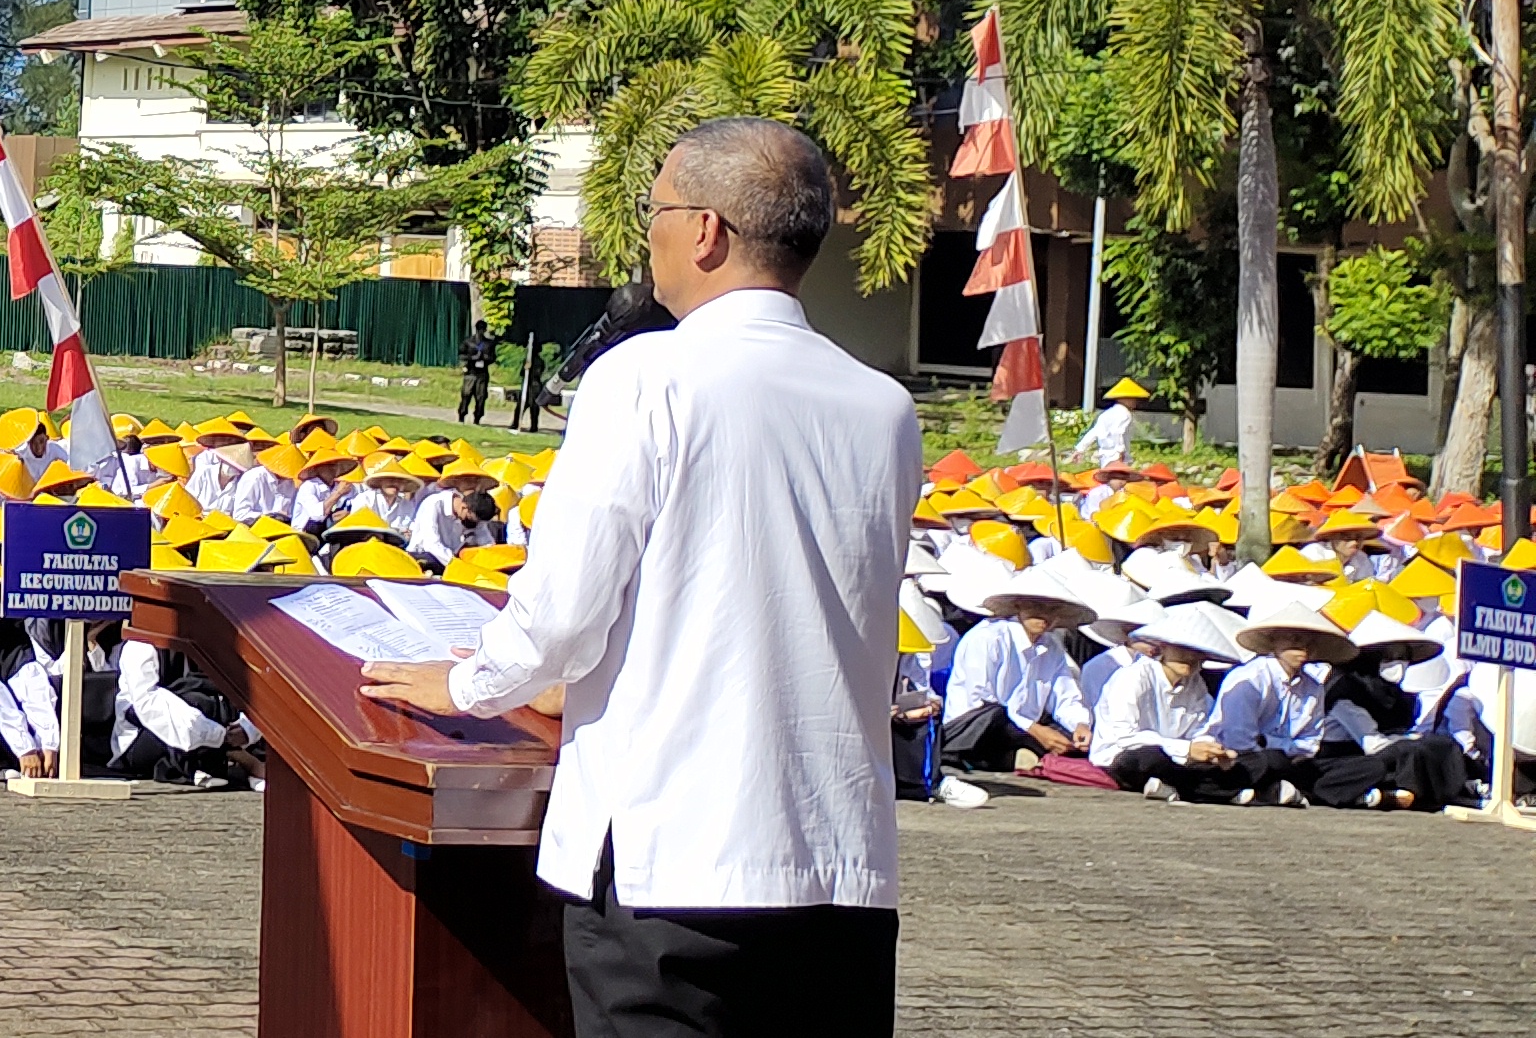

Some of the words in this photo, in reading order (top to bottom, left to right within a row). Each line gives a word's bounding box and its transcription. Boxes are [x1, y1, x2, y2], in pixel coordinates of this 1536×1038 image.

[43, 553, 118, 570] FAKULTAS
[20, 573, 104, 591] KEGURUAN
[107, 575, 119, 591] D
[7, 593, 49, 610] ILMU
[1460, 631, 1501, 659] ILMU
[1502, 638, 1536, 665] BUD
